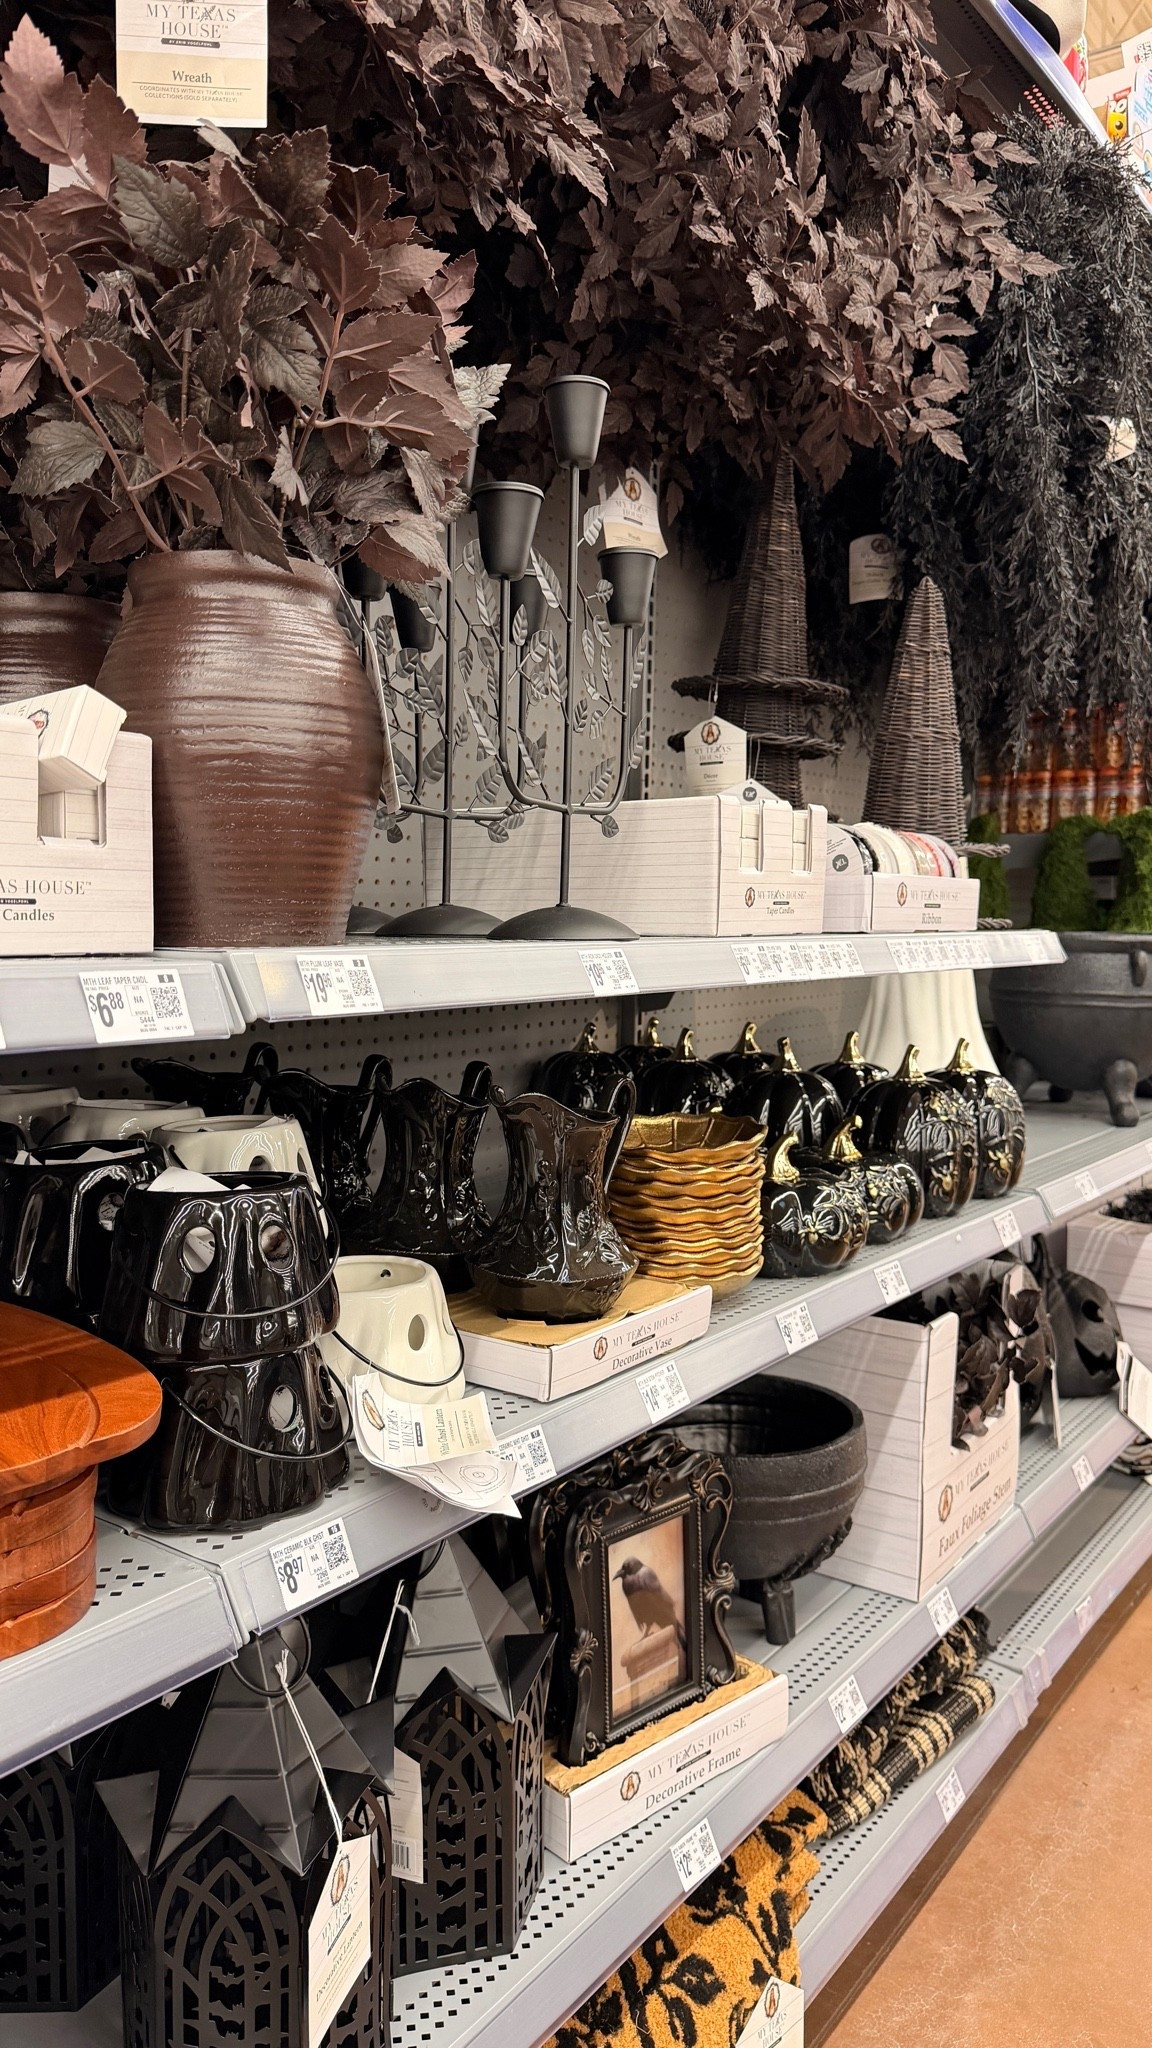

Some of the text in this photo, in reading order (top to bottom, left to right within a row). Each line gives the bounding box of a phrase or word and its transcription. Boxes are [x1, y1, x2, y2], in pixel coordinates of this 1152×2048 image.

[146, 3, 236, 22] MY TEXAS
[172, 70, 212, 84] Wreath
[140, 85, 180, 93] COORDINATES
[145, 92, 183, 100] COLLECTIONS
[2, 908, 55, 921] Candles
[83, 977, 96, 986] MTH
[98, 976, 112, 986] LEAF
[113, 976, 132, 985] TAPER
[133, 995, 144, 1003] NA
[613, 1335, 625, 1347] MY
[626, 1324, 652, 1342] TEXAS
[612, 1346, 653, 1370] Decorative
[655, 1337, 673, 1351] Vase
[939, 1477, 1012, 1558] Faux Foliage Stem
[283, 1541, 304, 1556] CERAMIC
[310, 1553, 319, 1562] NA
[648, 1763, 664, 1781] MY
[668, 1739, 704, 1769] TEXAS
[645, 1767, 705, 1810] Decorative
[708, 1747, 741, 1773] Frame
